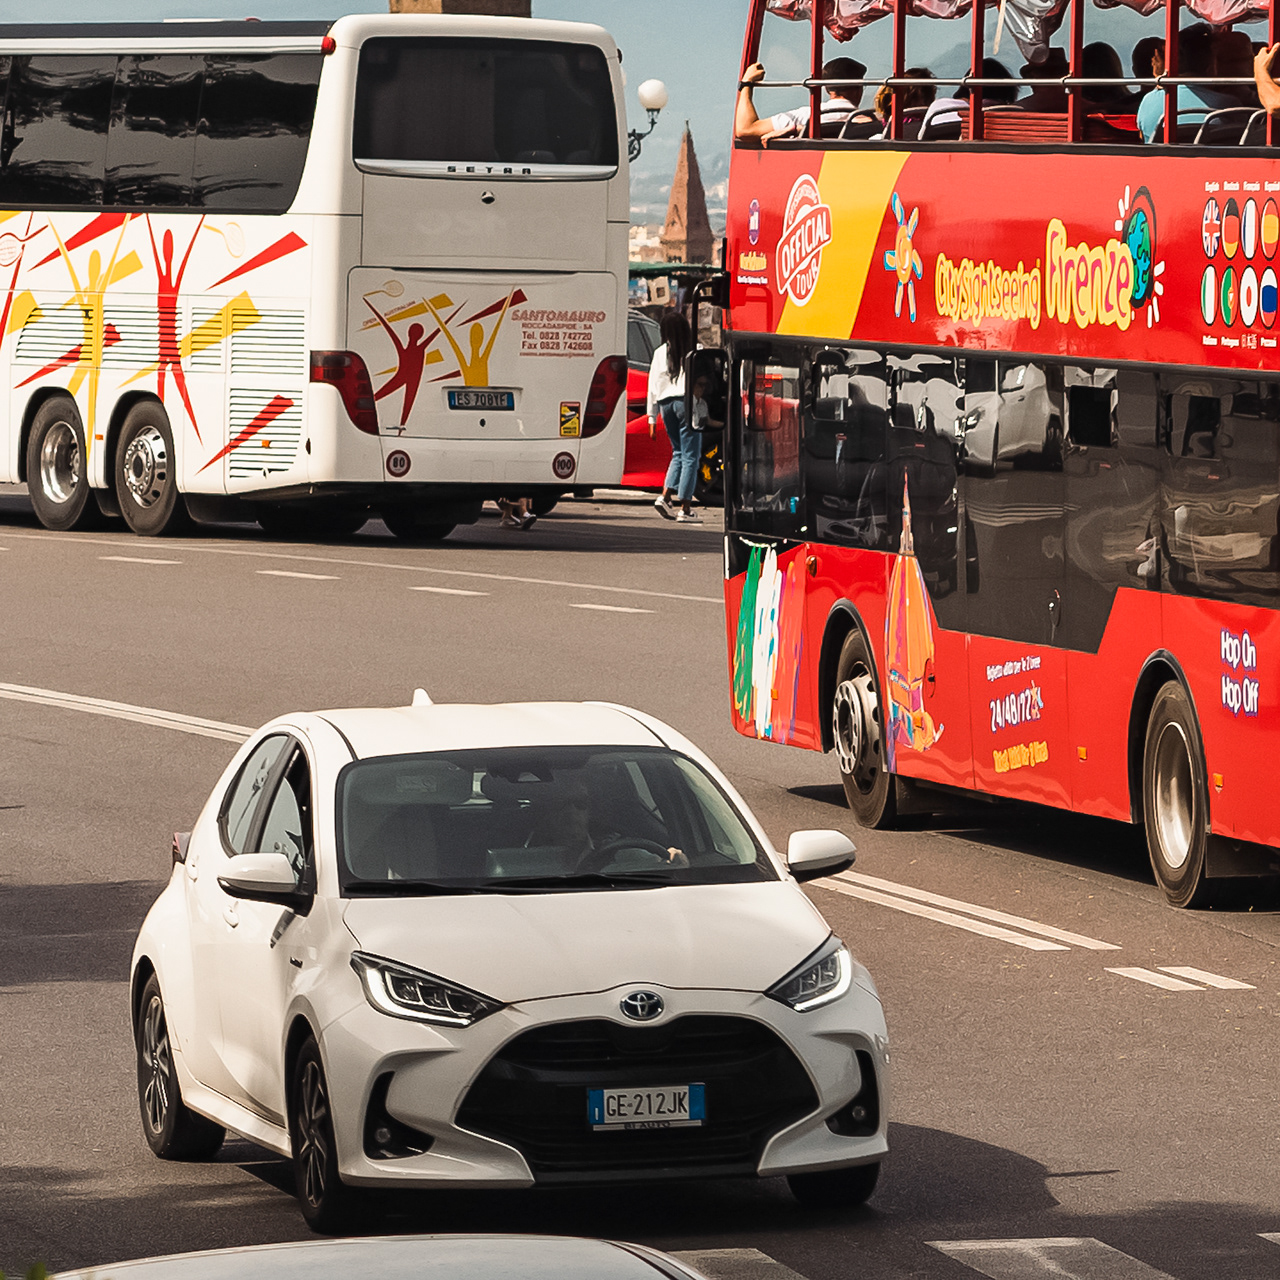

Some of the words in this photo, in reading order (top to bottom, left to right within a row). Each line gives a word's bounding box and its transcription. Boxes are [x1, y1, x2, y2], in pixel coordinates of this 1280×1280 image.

[781, 211, 830, 280] OFFICIAL
[795, 257, 819, 296] TOUR
[511, 309, 606, 323] SANTOMAURO
[521, 341, 537, 350] Fax
[539, 341, 560, 350] 0828
[522, 331, 537, 340] Tel.
[539, 331, 560, 340] 0828
[392, 456, 406, 469] 80
[556, 459, 572, 471] 100
[1221, 629, 1240, 670] Hop
[1241, 631, 1257, 670] On
[1221, 674, 1241, 715] Hop
[1242, 677, 1259, 715] Off
[989, 688, 1032, 733] 24/48/72
